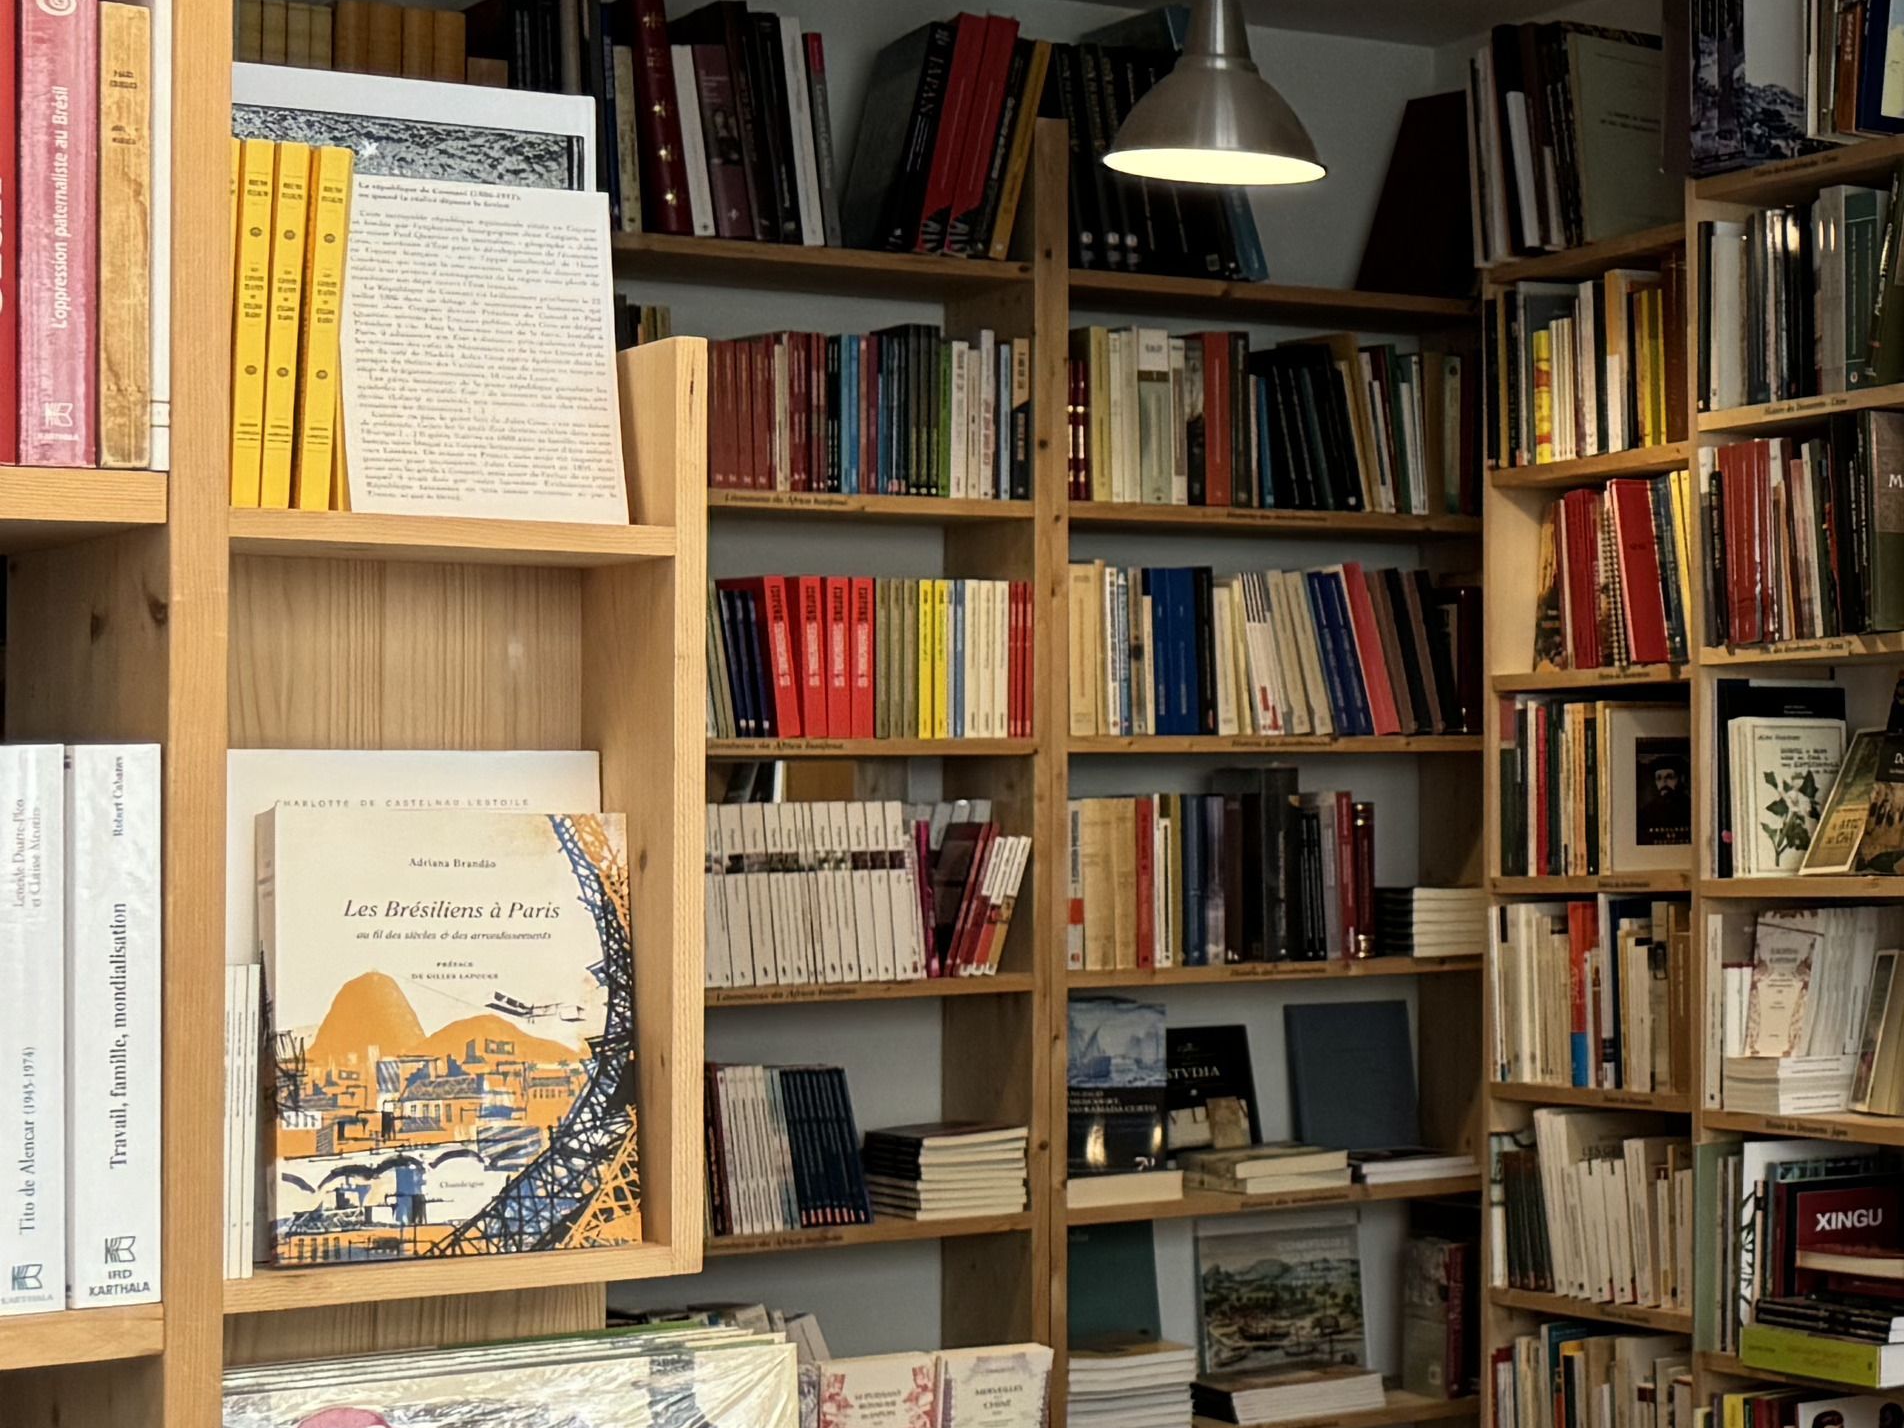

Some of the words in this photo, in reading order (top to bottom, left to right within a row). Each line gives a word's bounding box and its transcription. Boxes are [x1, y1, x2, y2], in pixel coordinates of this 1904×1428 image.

[343, 899, 378, 921] Les
[385, 897, 486, 921] Brésiliens
[508, 899, 560, 921] Paris
[111, 902, 127, 1025] mondialisation
[1815, 1207, 1883, 1234] XINGU
[89, 1281, 150, 1296] KARTHALA
